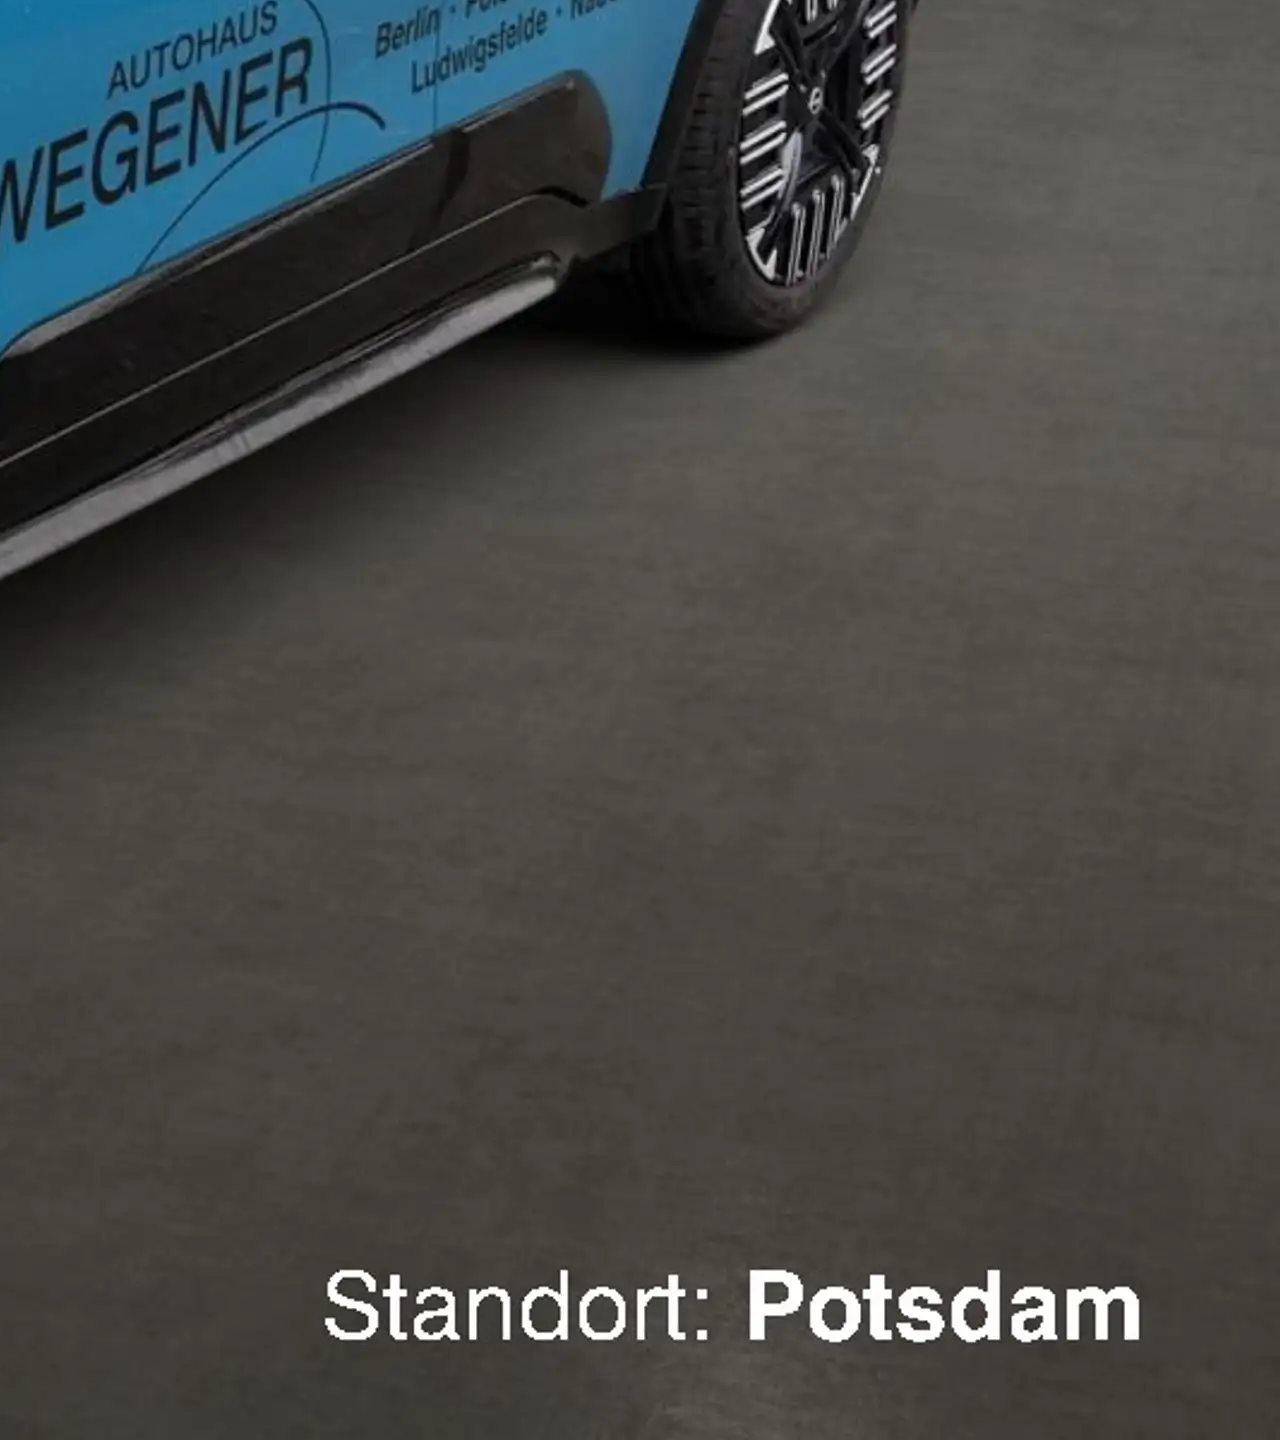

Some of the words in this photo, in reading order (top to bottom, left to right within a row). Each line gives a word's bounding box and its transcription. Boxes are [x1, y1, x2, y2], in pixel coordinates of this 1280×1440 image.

[107, 0, 278, 100] AUTOHAUS
[376, 5, 440, 58] Berlin
[411, 6, 547, 95] Ludwigsfelde
